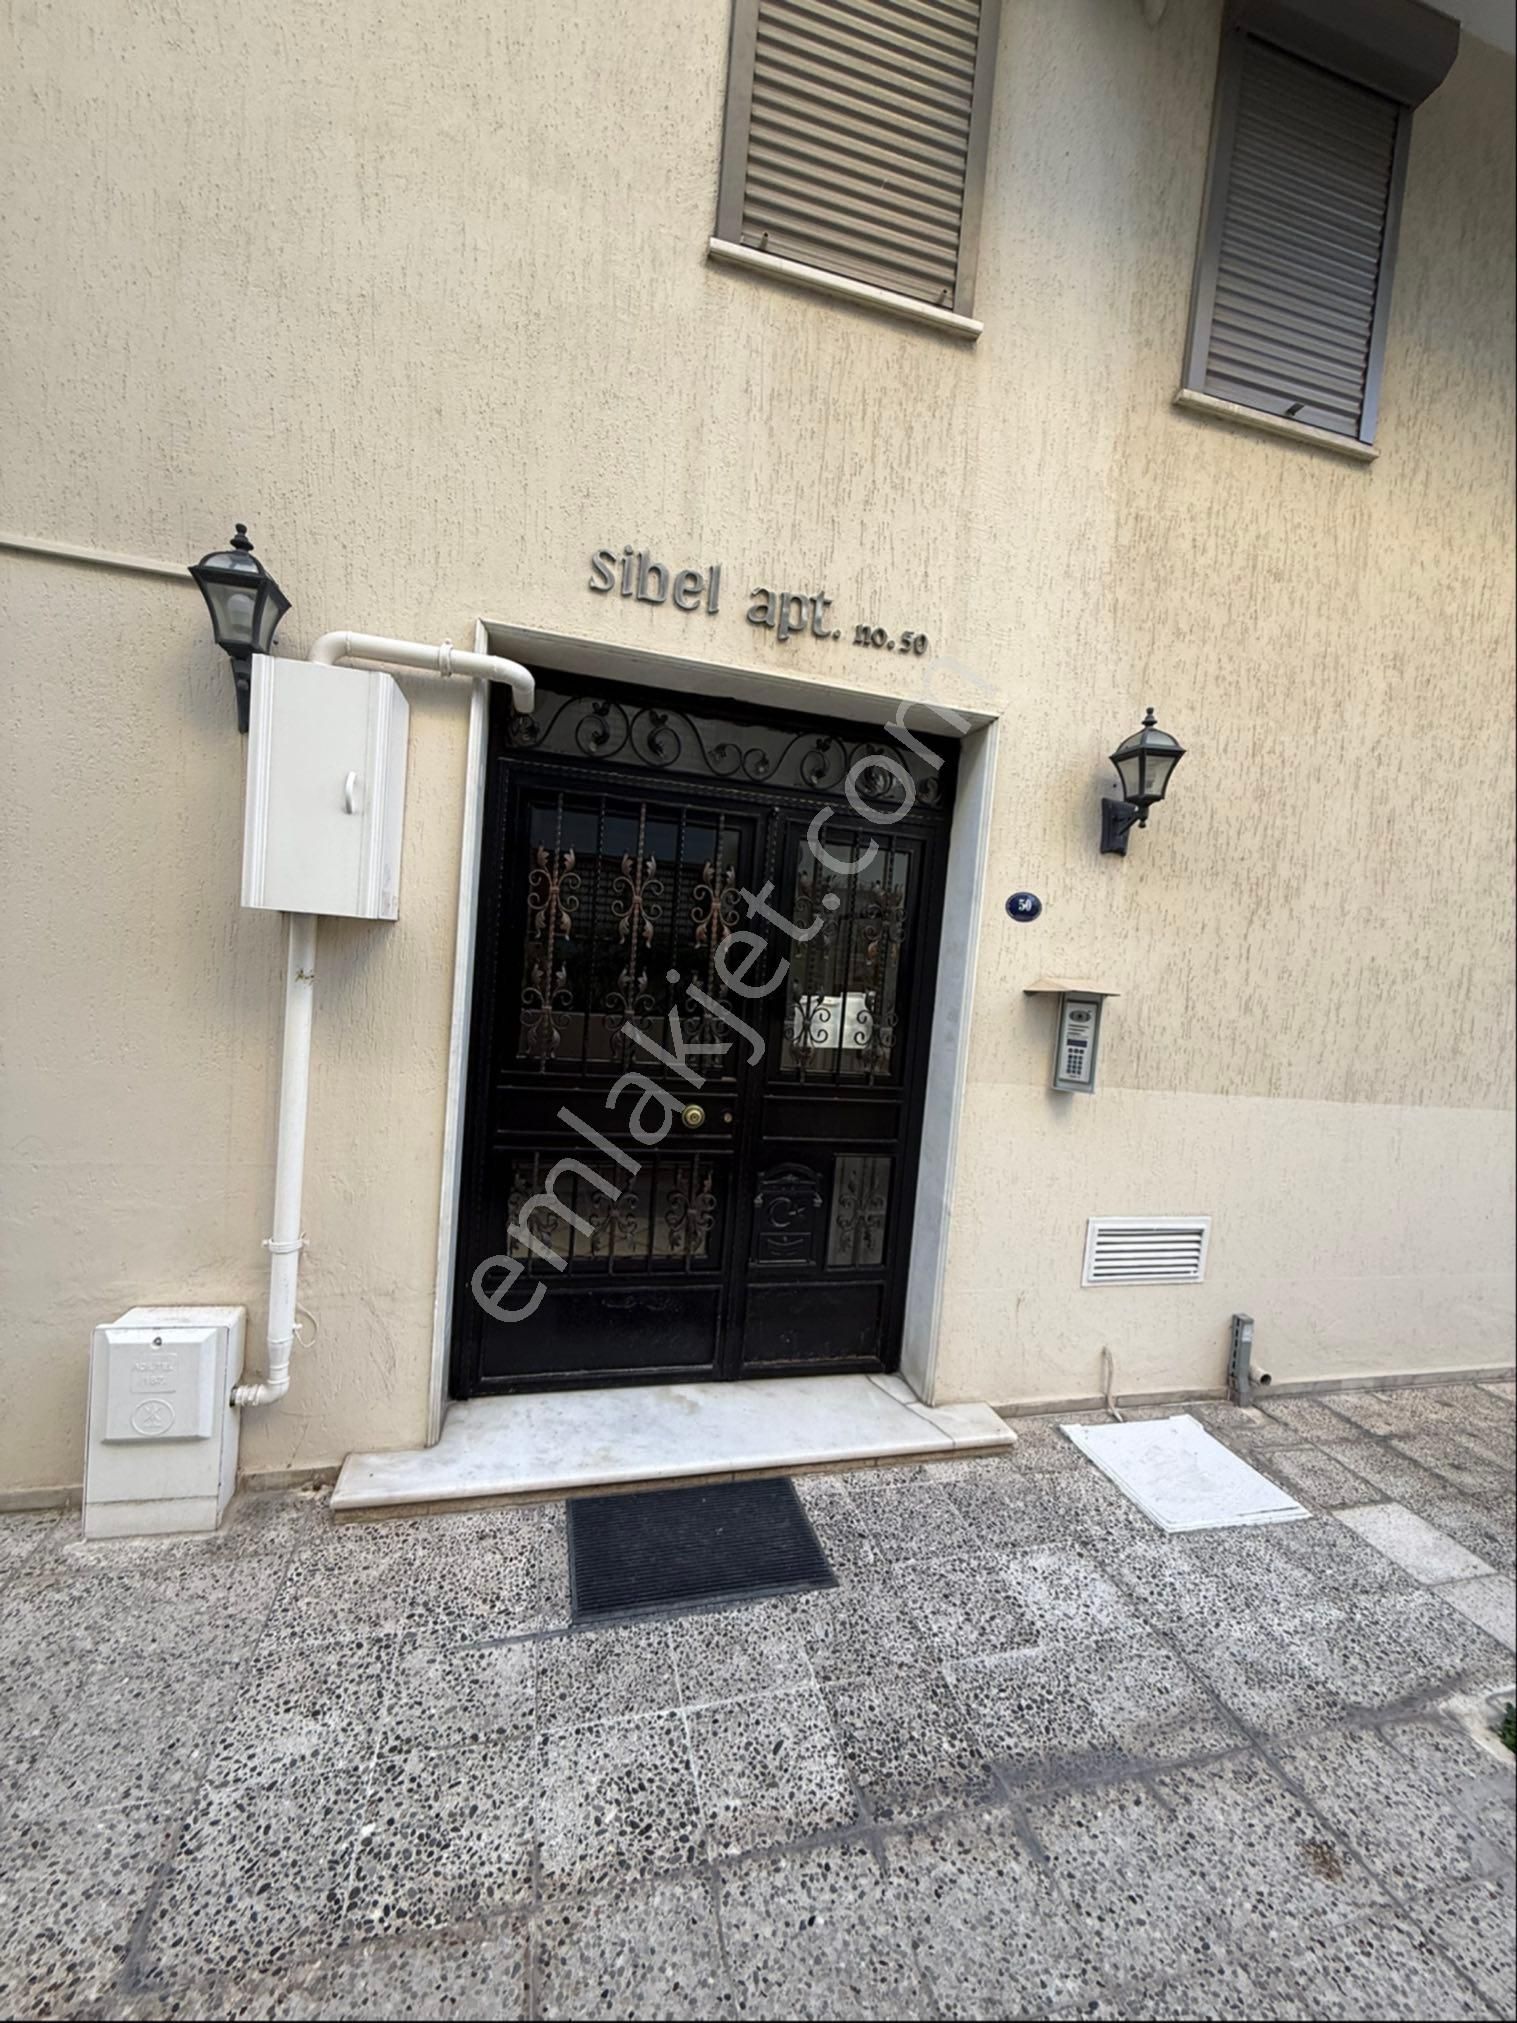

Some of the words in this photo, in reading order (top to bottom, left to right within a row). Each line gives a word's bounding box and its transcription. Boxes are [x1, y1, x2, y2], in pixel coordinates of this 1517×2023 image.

[589, 545, 722, 615] sibel
[746, 586, 841, 641] apt.
[1018, 898, 1032, 911] 50
